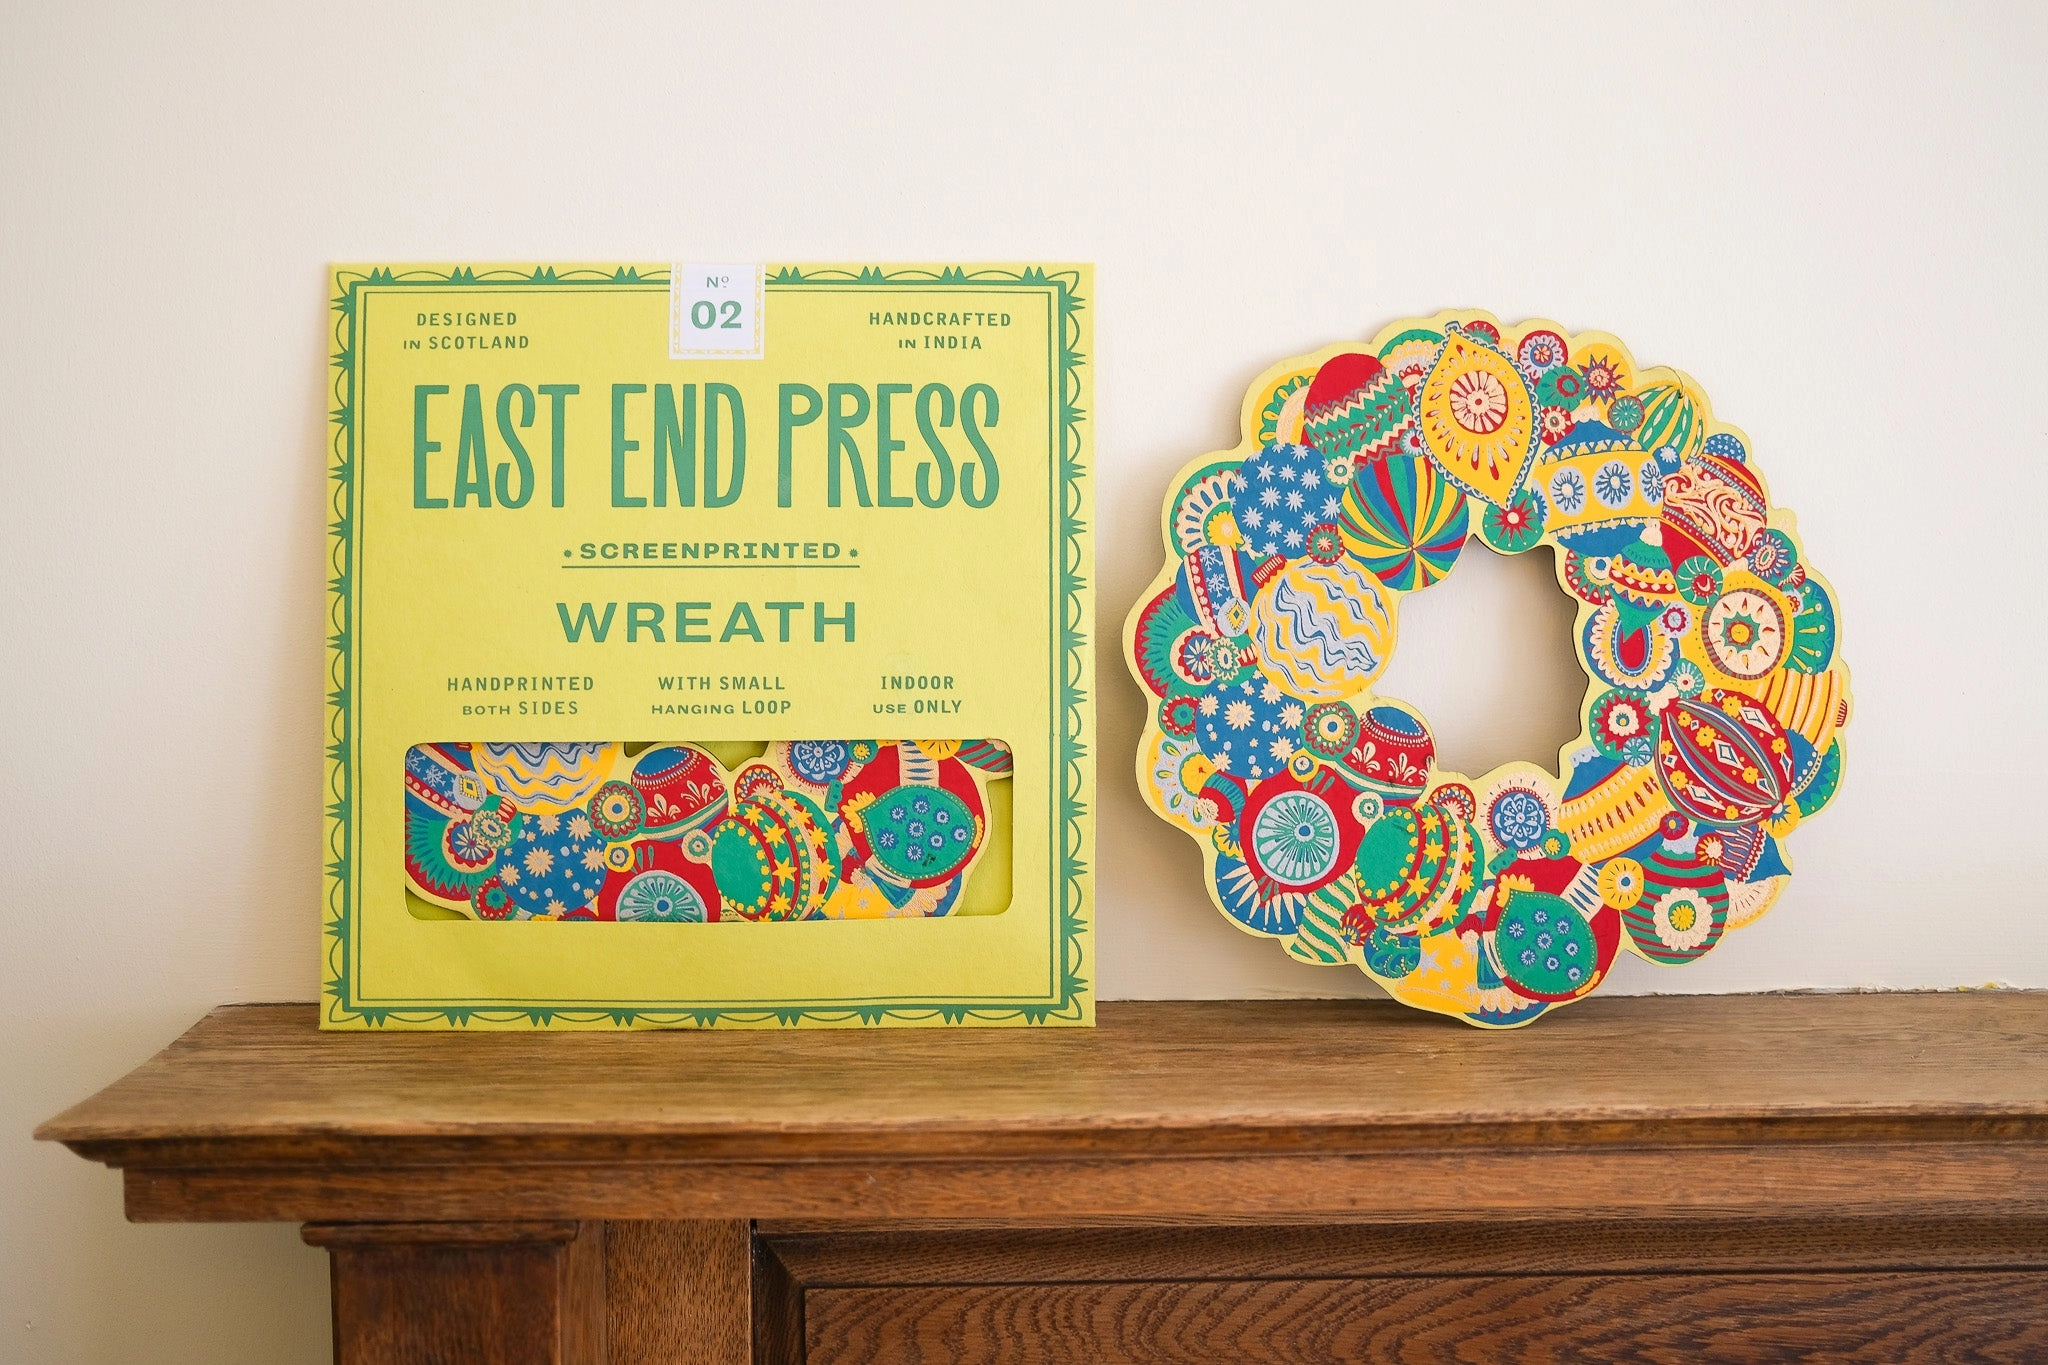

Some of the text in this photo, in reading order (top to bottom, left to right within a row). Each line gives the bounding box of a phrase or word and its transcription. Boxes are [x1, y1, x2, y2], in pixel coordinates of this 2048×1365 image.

[417, 312, 517, 326] DESIGNED
[691, 301, 742, 329] 02
[869, 312, 1011, 326] HANDCRAFTED
[403, 336, 529, 350] IN SCOTLAND
[898, 335, 982, 349] IN INDIA
[413, 382, 1000, 510] EAST END PRESS
[580, 542, 841, 560] SCREENPRINTED
[555, 601, 856, 643] WREATH
[447, 676, 594, 692] HANDPRINTED
[658, 676, 785, 691] WITH SMALL
[881, 675, 954, 690] INDOOR
[462, 700, 578, 716] BOTH SIDES
[651, 700, 791, 715] HANGING LOOP
[873, 699, 962, 714] USE ONLY
